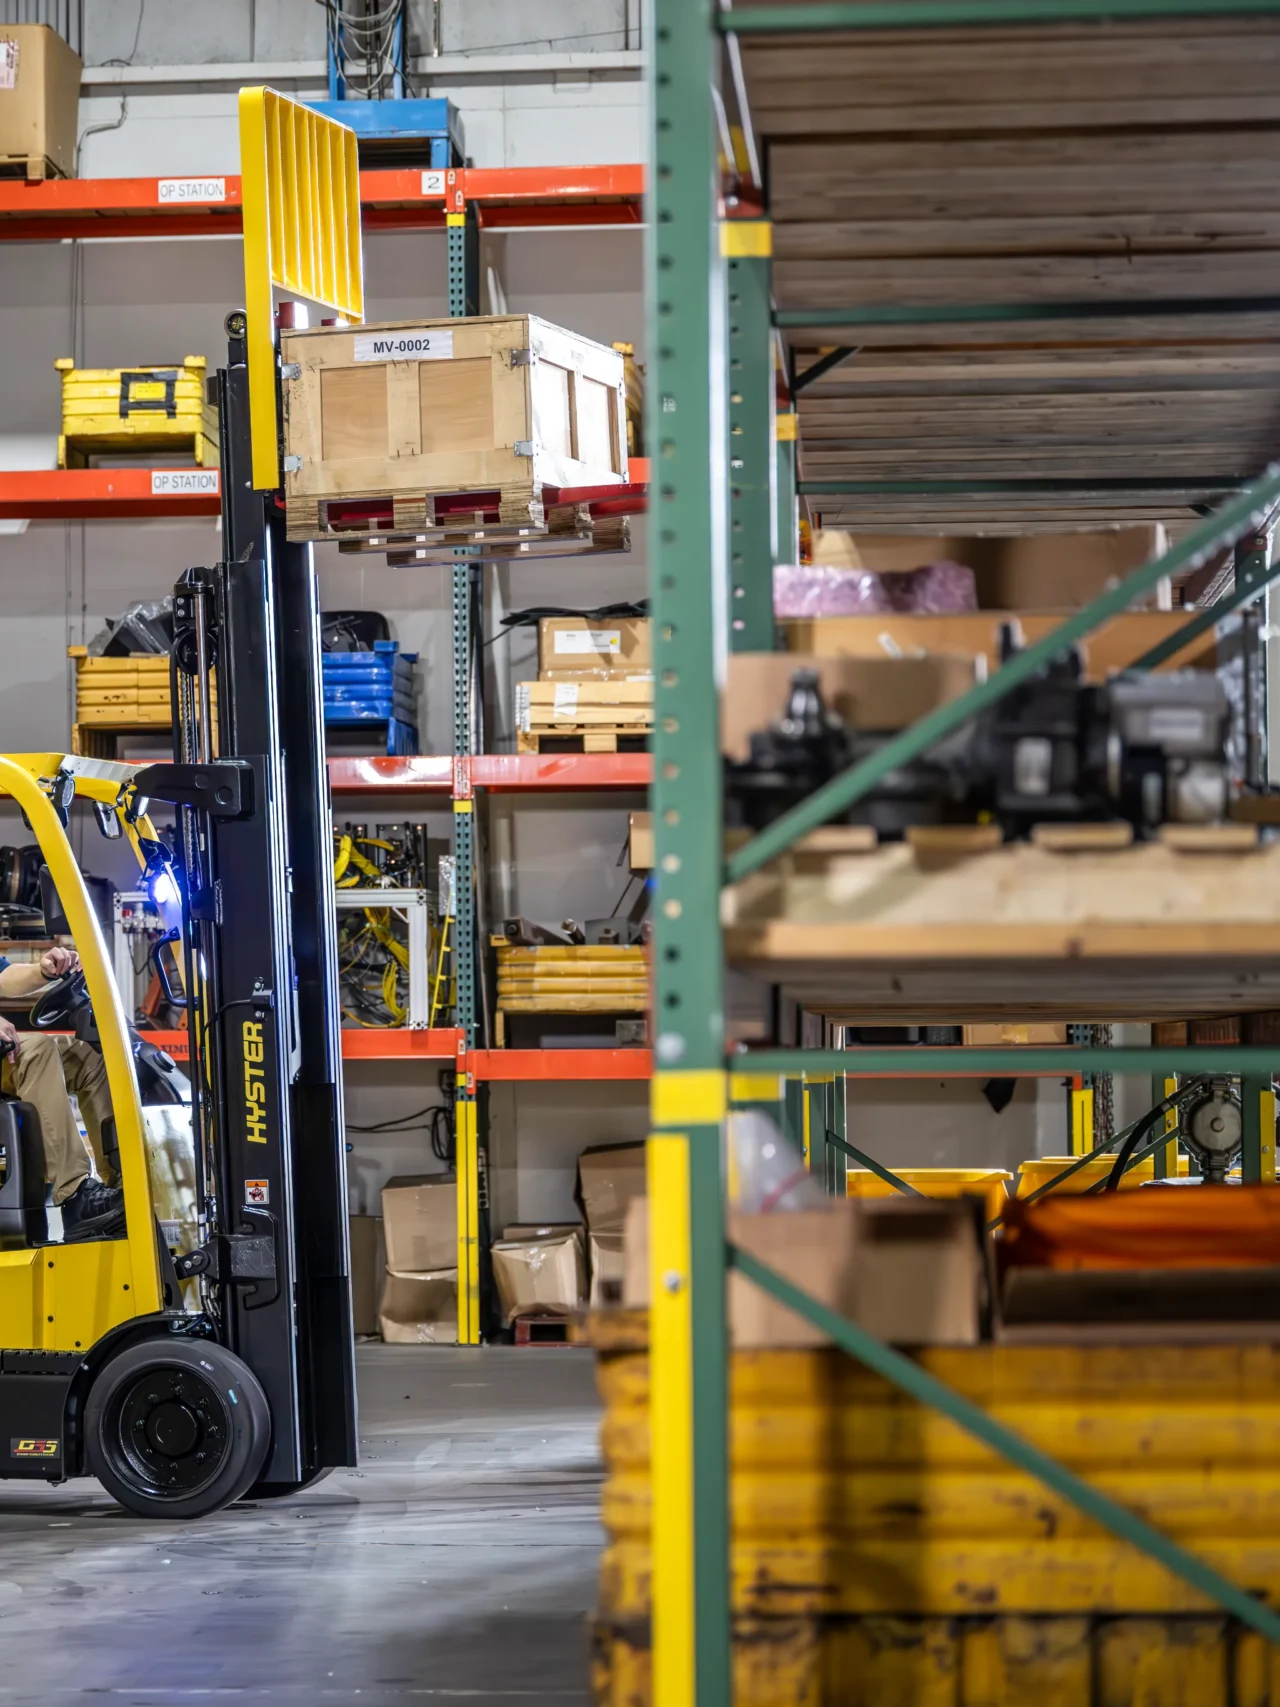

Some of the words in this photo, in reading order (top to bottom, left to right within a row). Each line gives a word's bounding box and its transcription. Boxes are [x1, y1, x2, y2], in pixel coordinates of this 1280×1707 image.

[160, 183, 176, 197] OP
[178, 182, 223, 197] STATION
[427, 176, 440, 189] 2
[373, 339, 430, 353] MV-0002
[153, 476, 169, 489] OP
[172, 475, 216, 488] STATION
[242, 1021, 267, 1144] HYSTER
